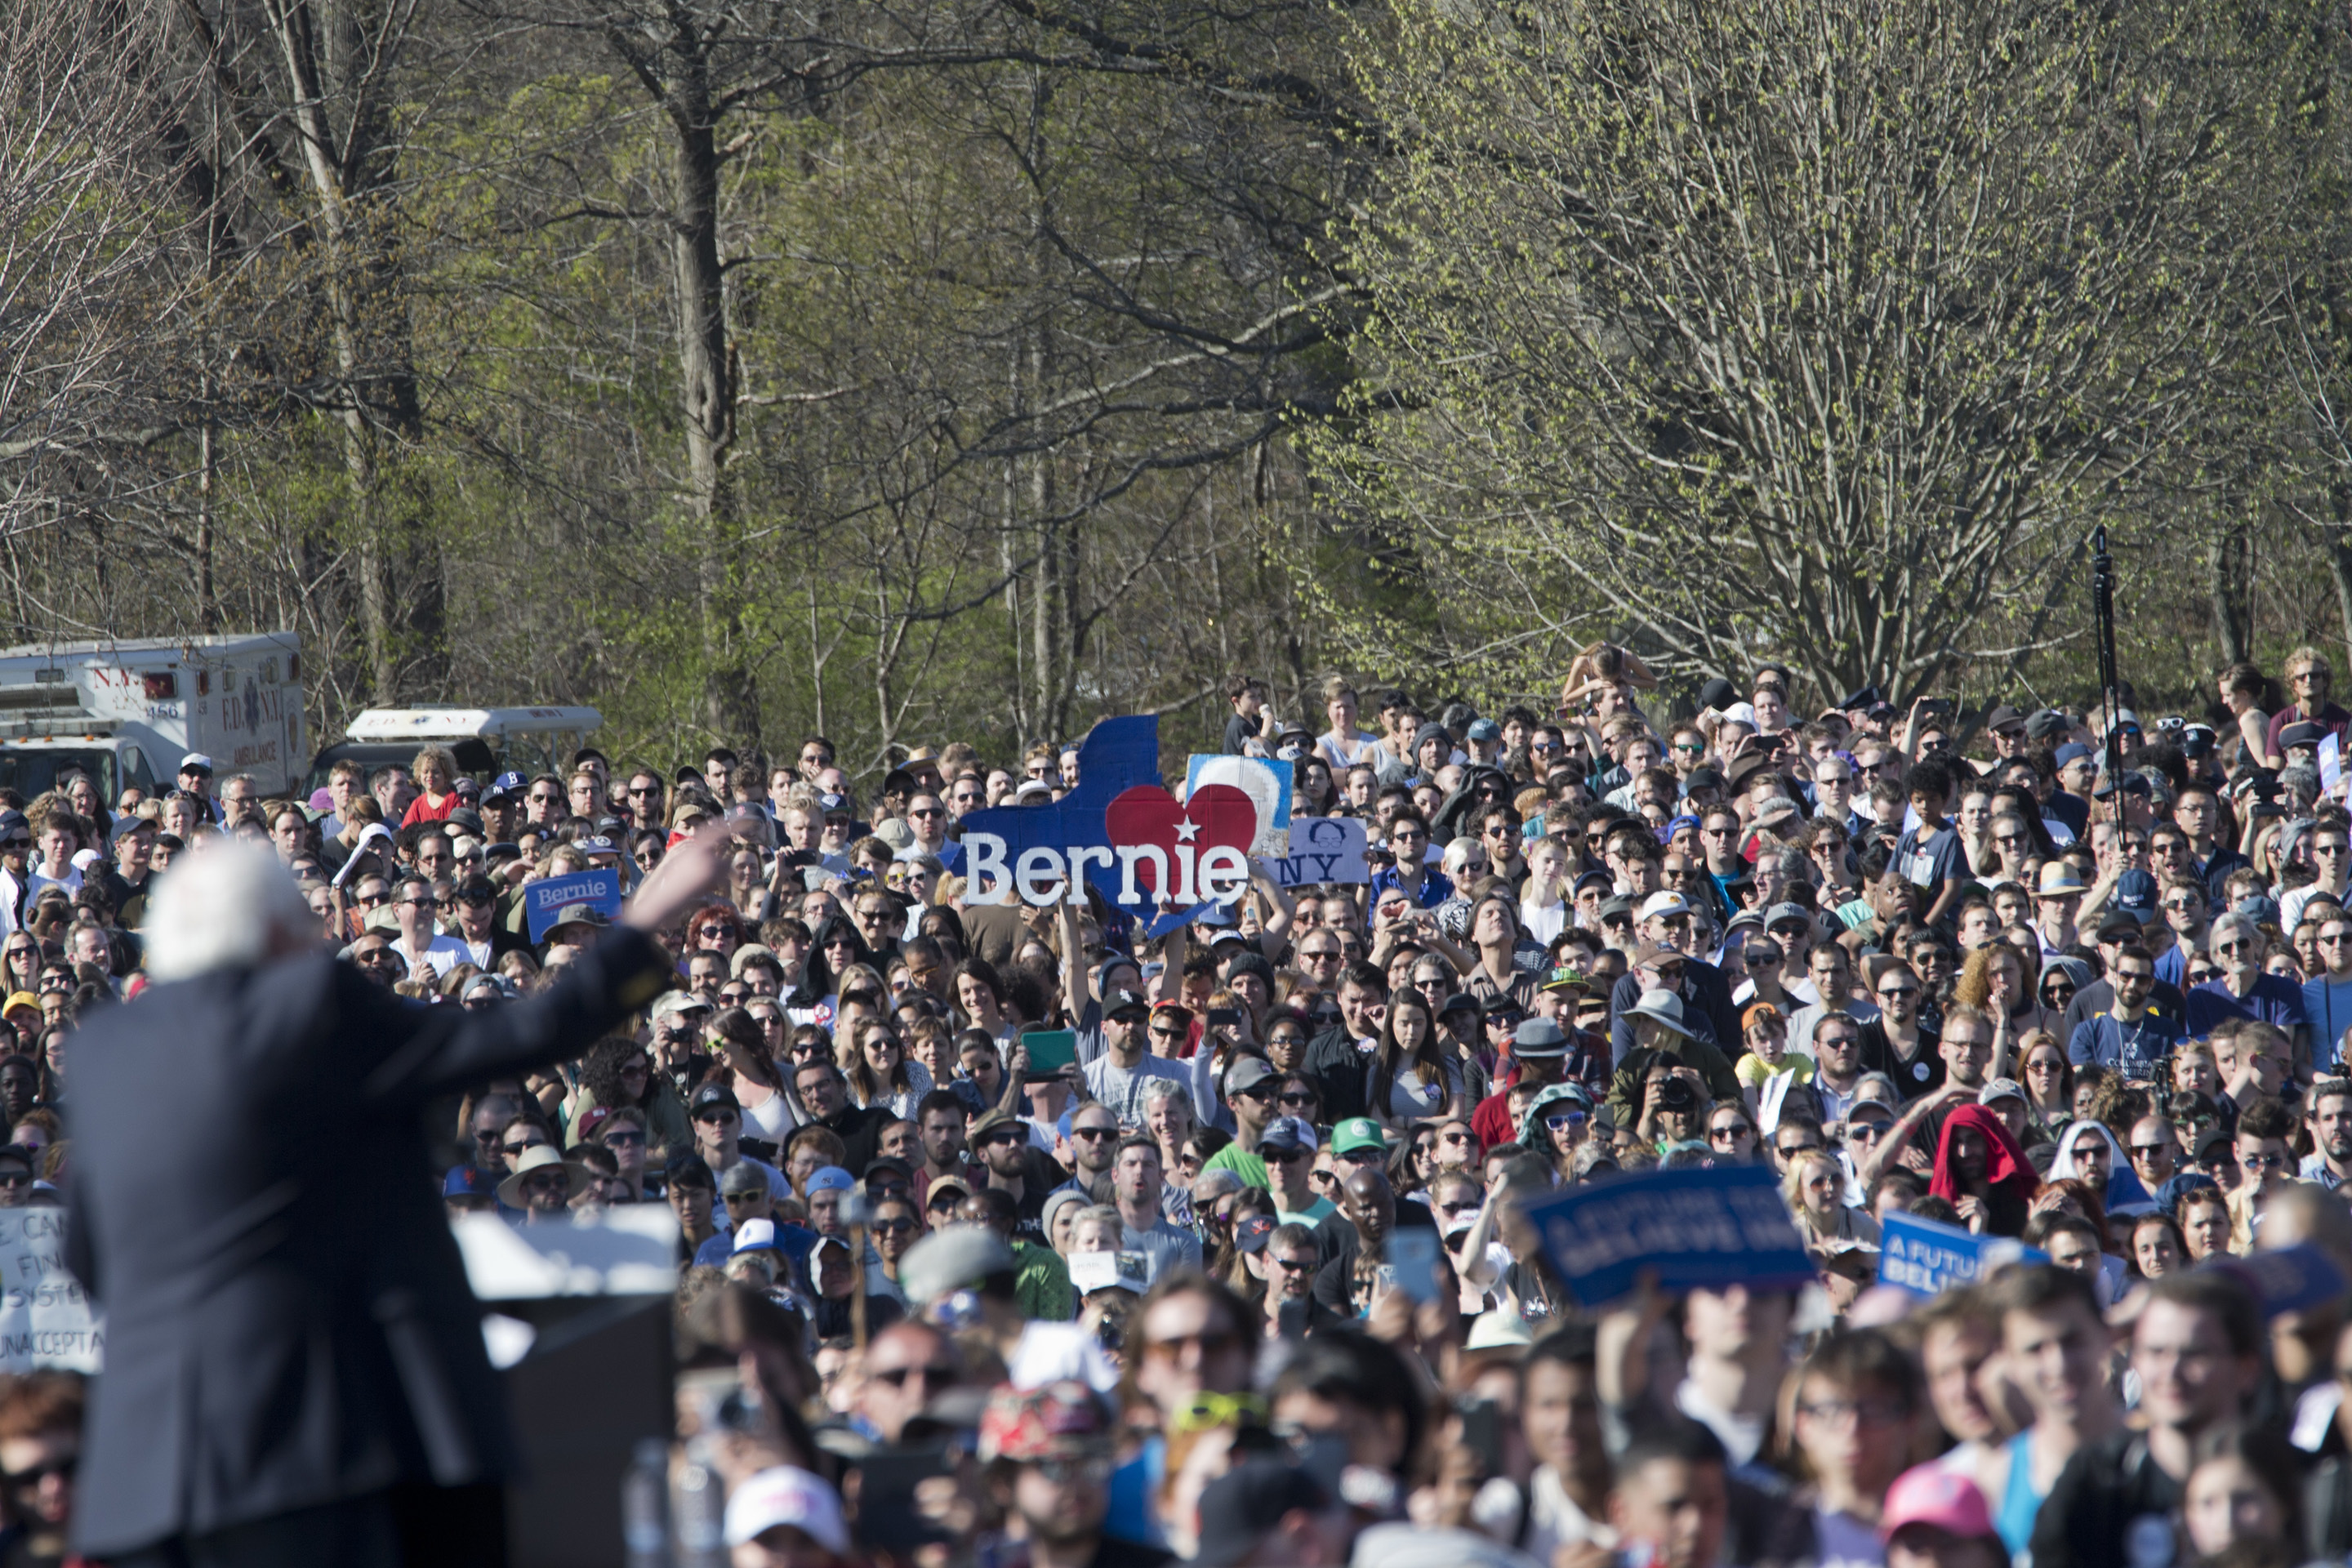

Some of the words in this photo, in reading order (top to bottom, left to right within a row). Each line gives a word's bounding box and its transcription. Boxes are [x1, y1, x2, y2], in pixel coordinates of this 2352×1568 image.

[234, 741, 276, 768] AMBULANCE
[960, 832, 1250, 906] Bernie
[1274, 853, 1343, 885] NY
[537, 880, 607, 908] Bernie
[1886, 1233, 1906, 1258] A
[1883, 1254, 1963, 1294] BELI
[7, 1282, 89, 1308] SYSTE
